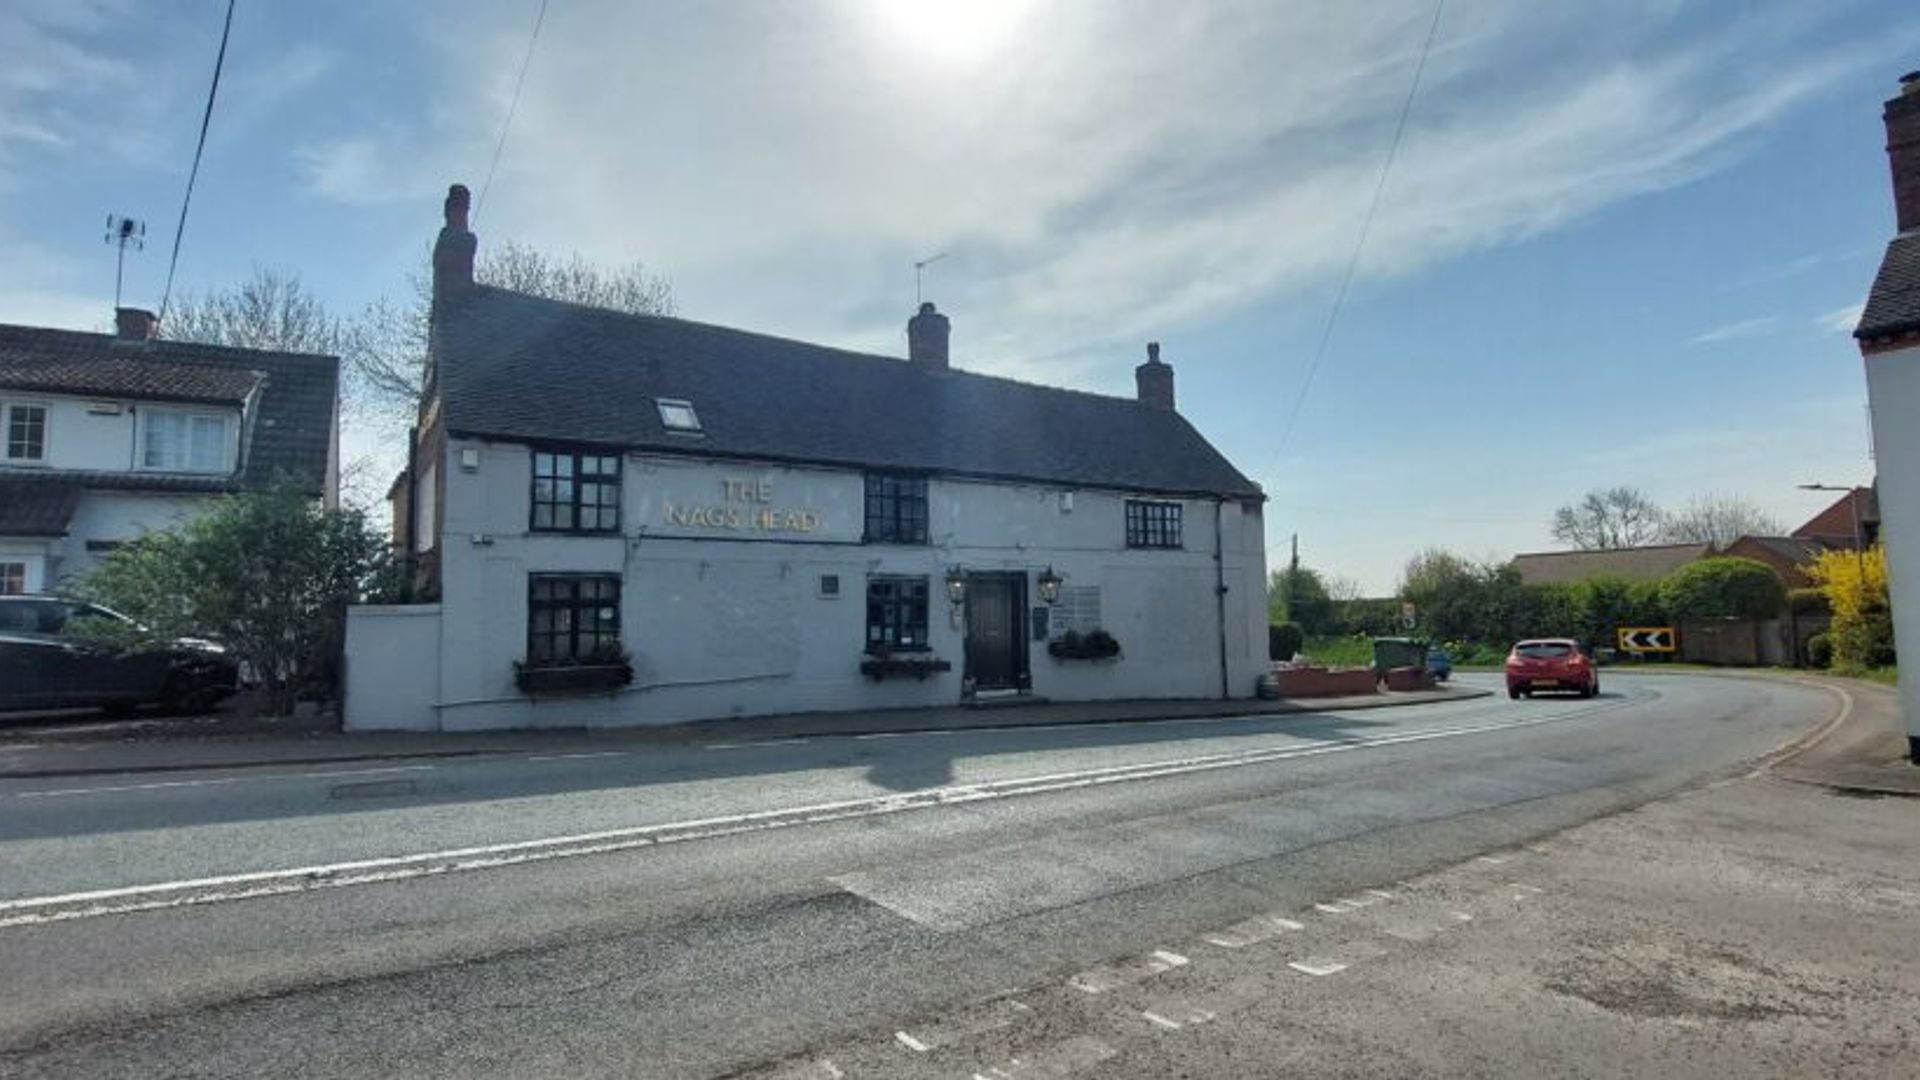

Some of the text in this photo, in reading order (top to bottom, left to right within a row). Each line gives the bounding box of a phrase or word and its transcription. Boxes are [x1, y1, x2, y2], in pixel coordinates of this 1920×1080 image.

[721, 475, 775, 503] THE
[664, 502, 824, 534] NAGS HEAD
